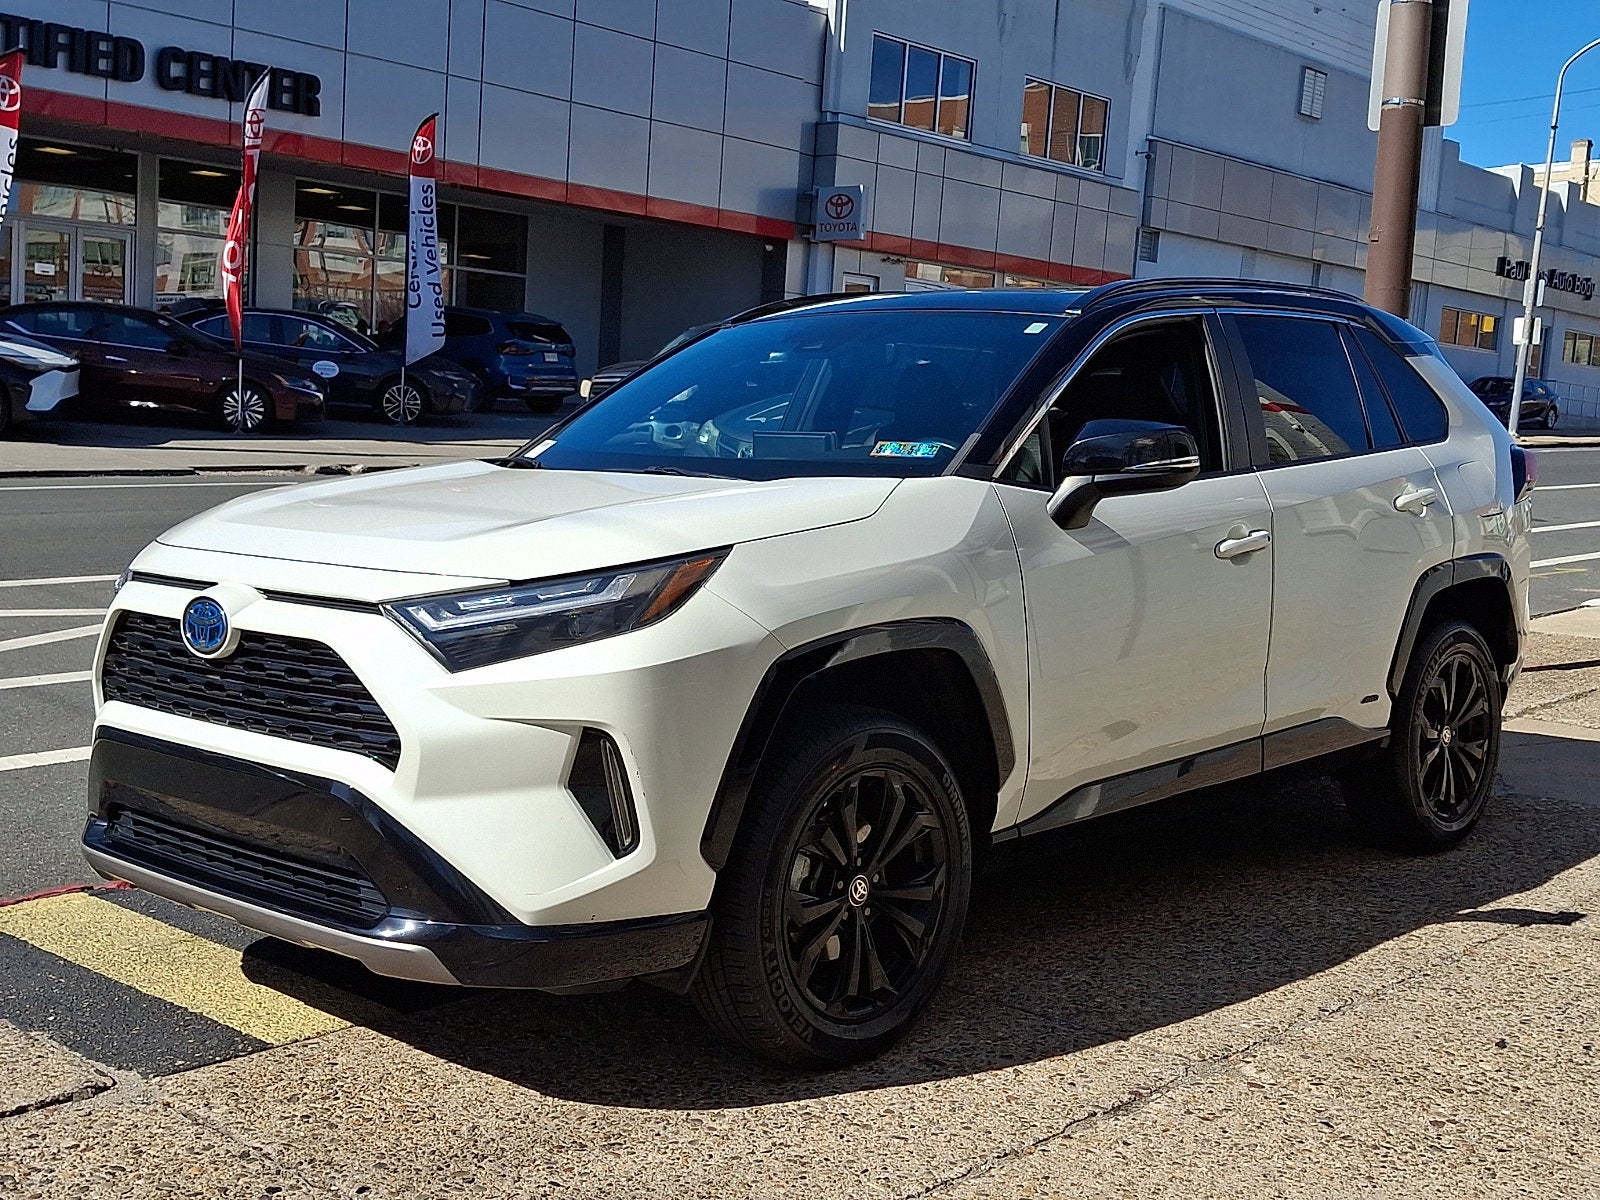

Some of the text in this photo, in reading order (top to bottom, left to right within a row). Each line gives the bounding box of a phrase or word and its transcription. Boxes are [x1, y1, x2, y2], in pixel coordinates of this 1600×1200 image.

[157, 46, 321, 117] CENTER
[418, 184, 446, 338] Used Vehicles
[819, 222, 858, 233] TOYOTA
[1502, 256, 1526, 280] Paul
[1551, 269, 1573, 291] Auto
[762, 940, 814, 1043] VELOCITY
